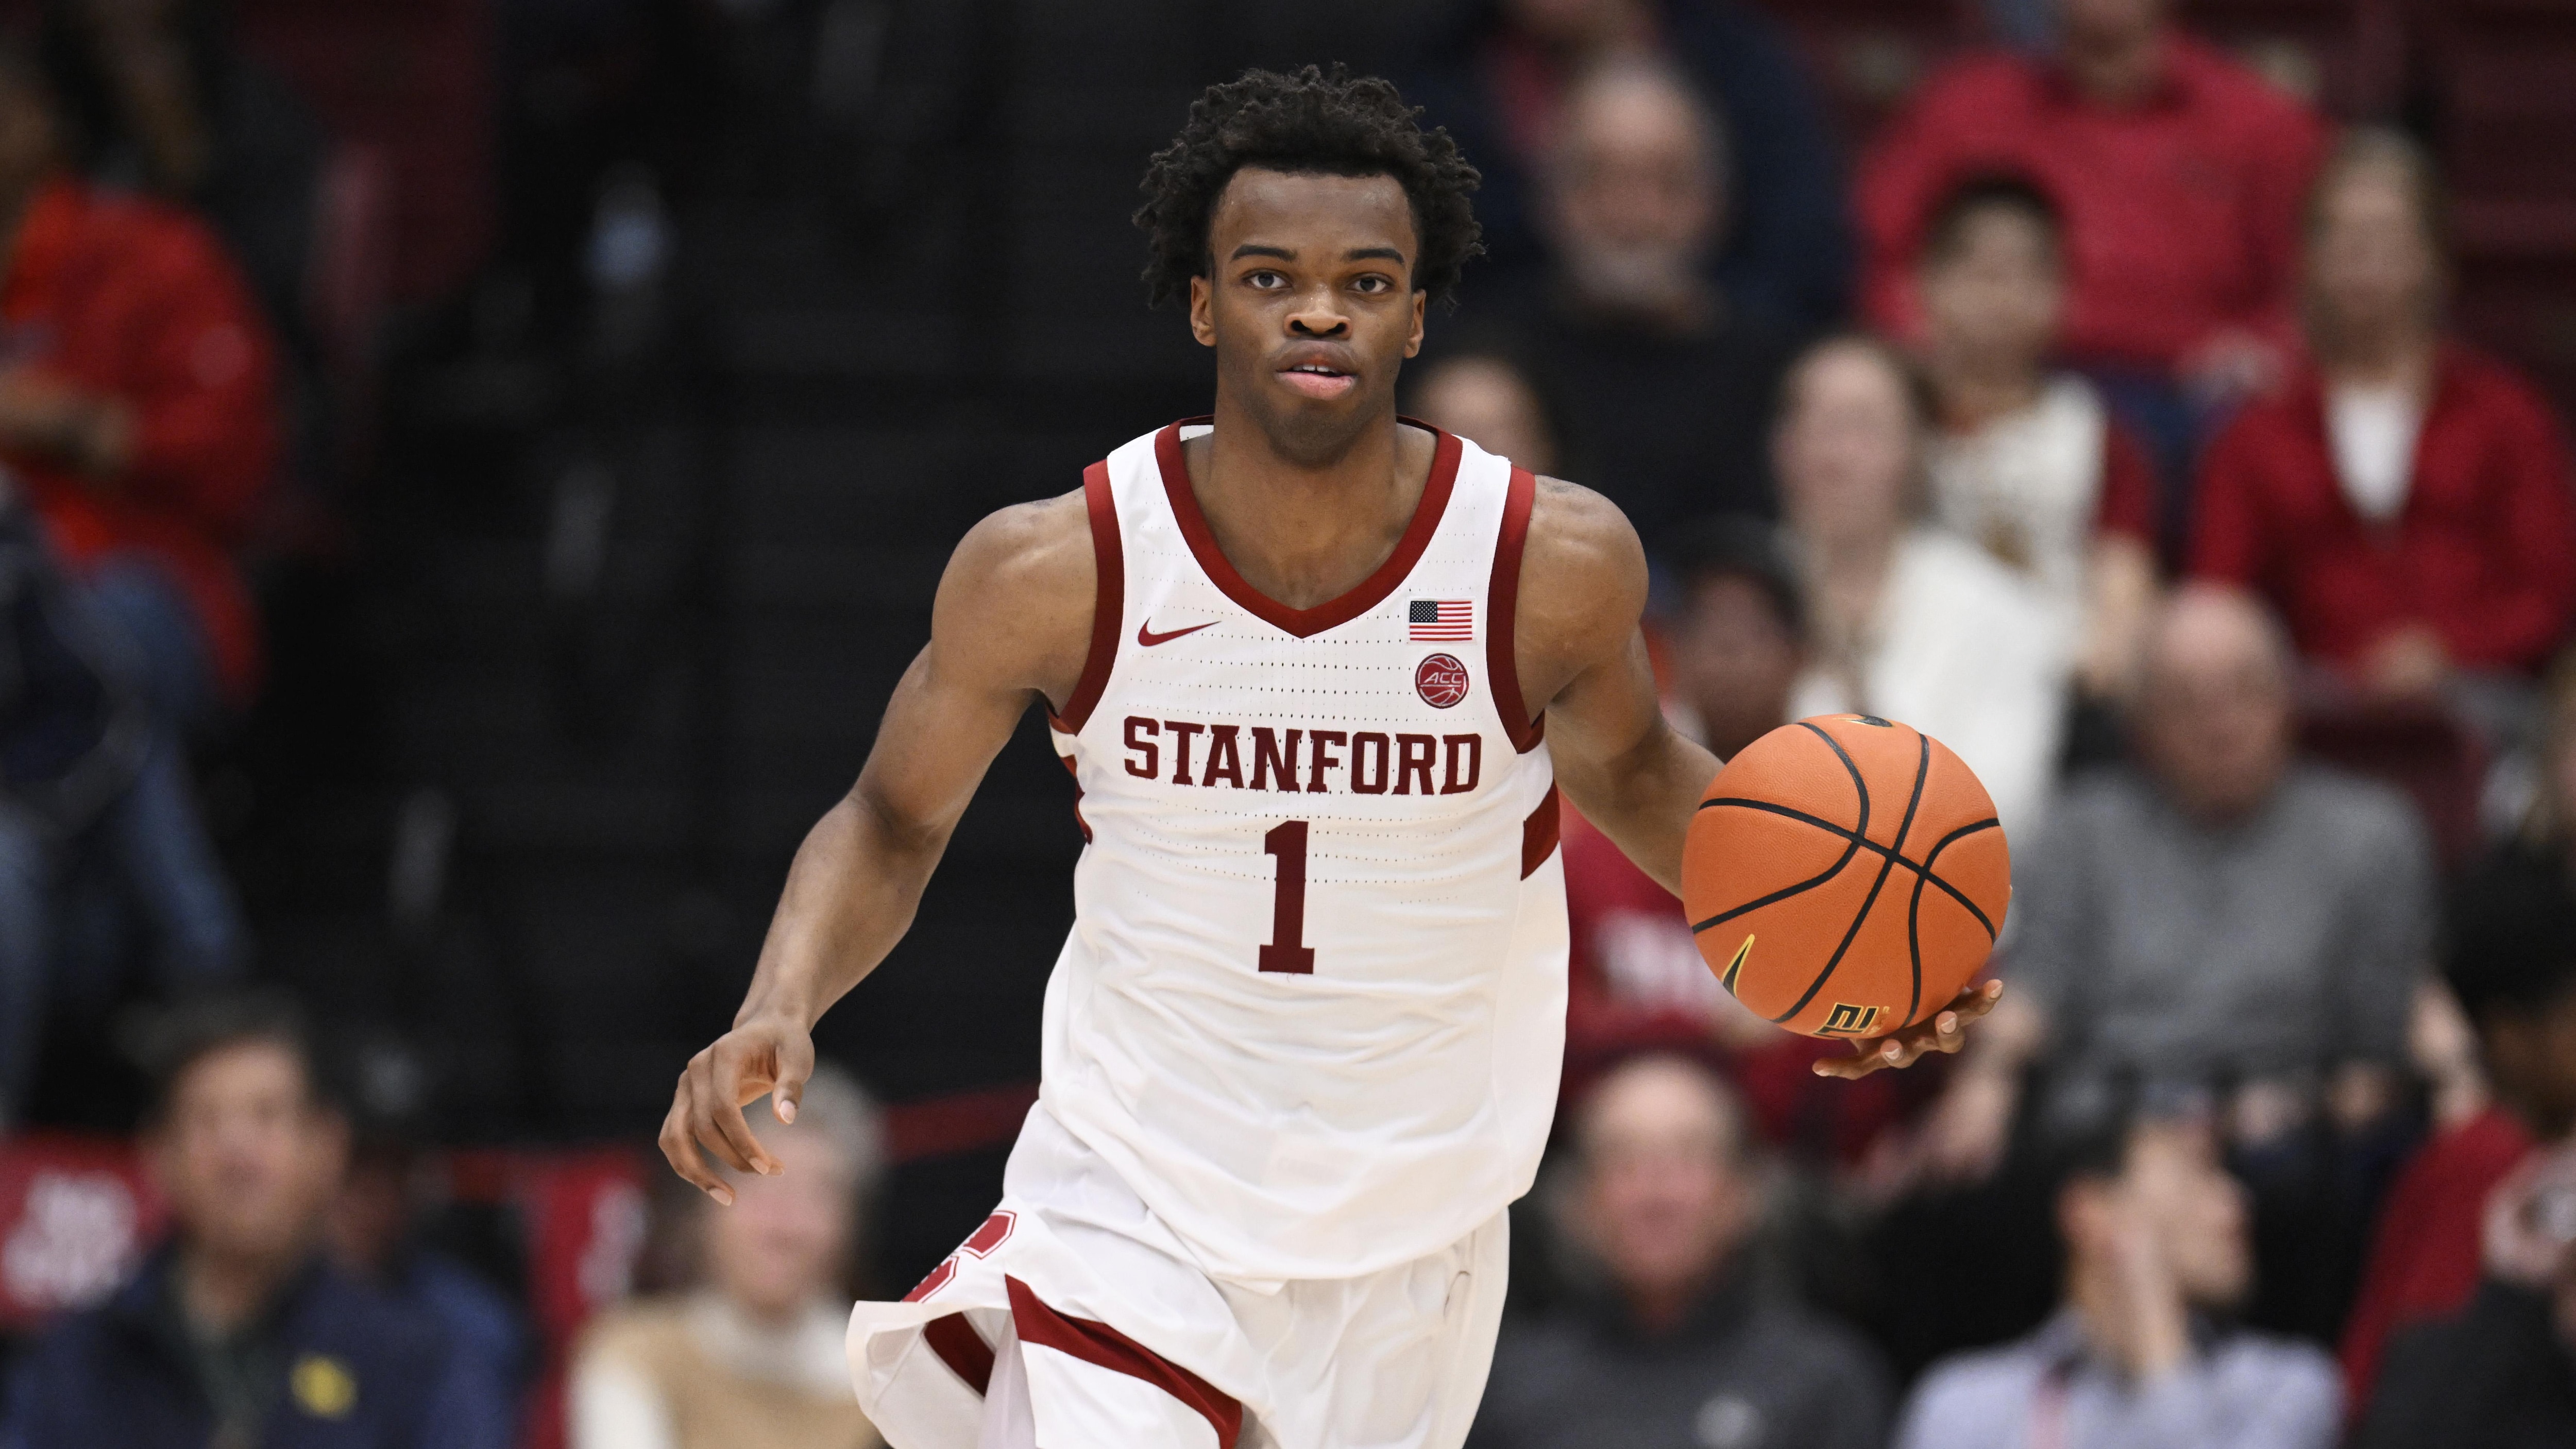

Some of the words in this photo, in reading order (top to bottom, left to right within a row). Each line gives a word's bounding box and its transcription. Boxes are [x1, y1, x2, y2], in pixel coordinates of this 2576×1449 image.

[1423, 672, 1464, 684] ACC
[1124, 715, 1482, 795] STANFORD
[1258, 820, 1315, 974] 1
